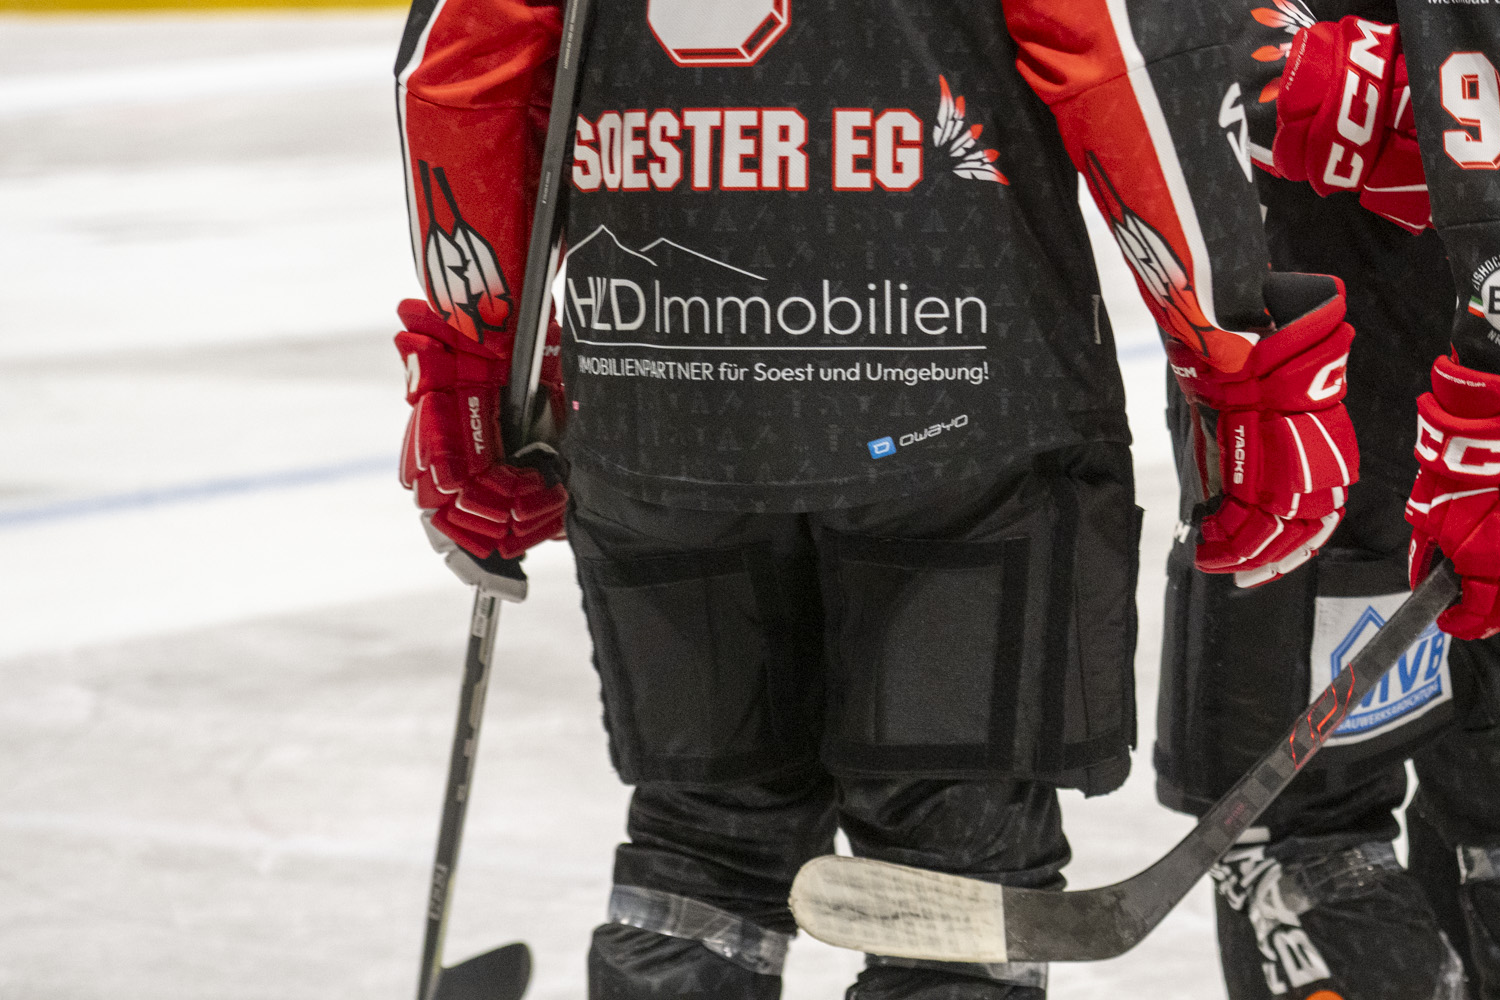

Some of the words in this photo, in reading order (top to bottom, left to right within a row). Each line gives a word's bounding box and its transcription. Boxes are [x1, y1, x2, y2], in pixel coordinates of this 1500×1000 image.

[1322, 18, 1393, 188] CCM
[572, 107, 810, 193] SOESTER
[831, 107, 924, 192] EG
[654, 279, 988, 335] Immobilien
[718, 363, 750, 381] für
[753, 362, 814, 382] Soest
[819, 363, 861, 381] und
[866, 362, 989, 385] Umgebung!
[468, 396, 482, 454] TACKS
[1233, 424, 1246, 485] TACKS
